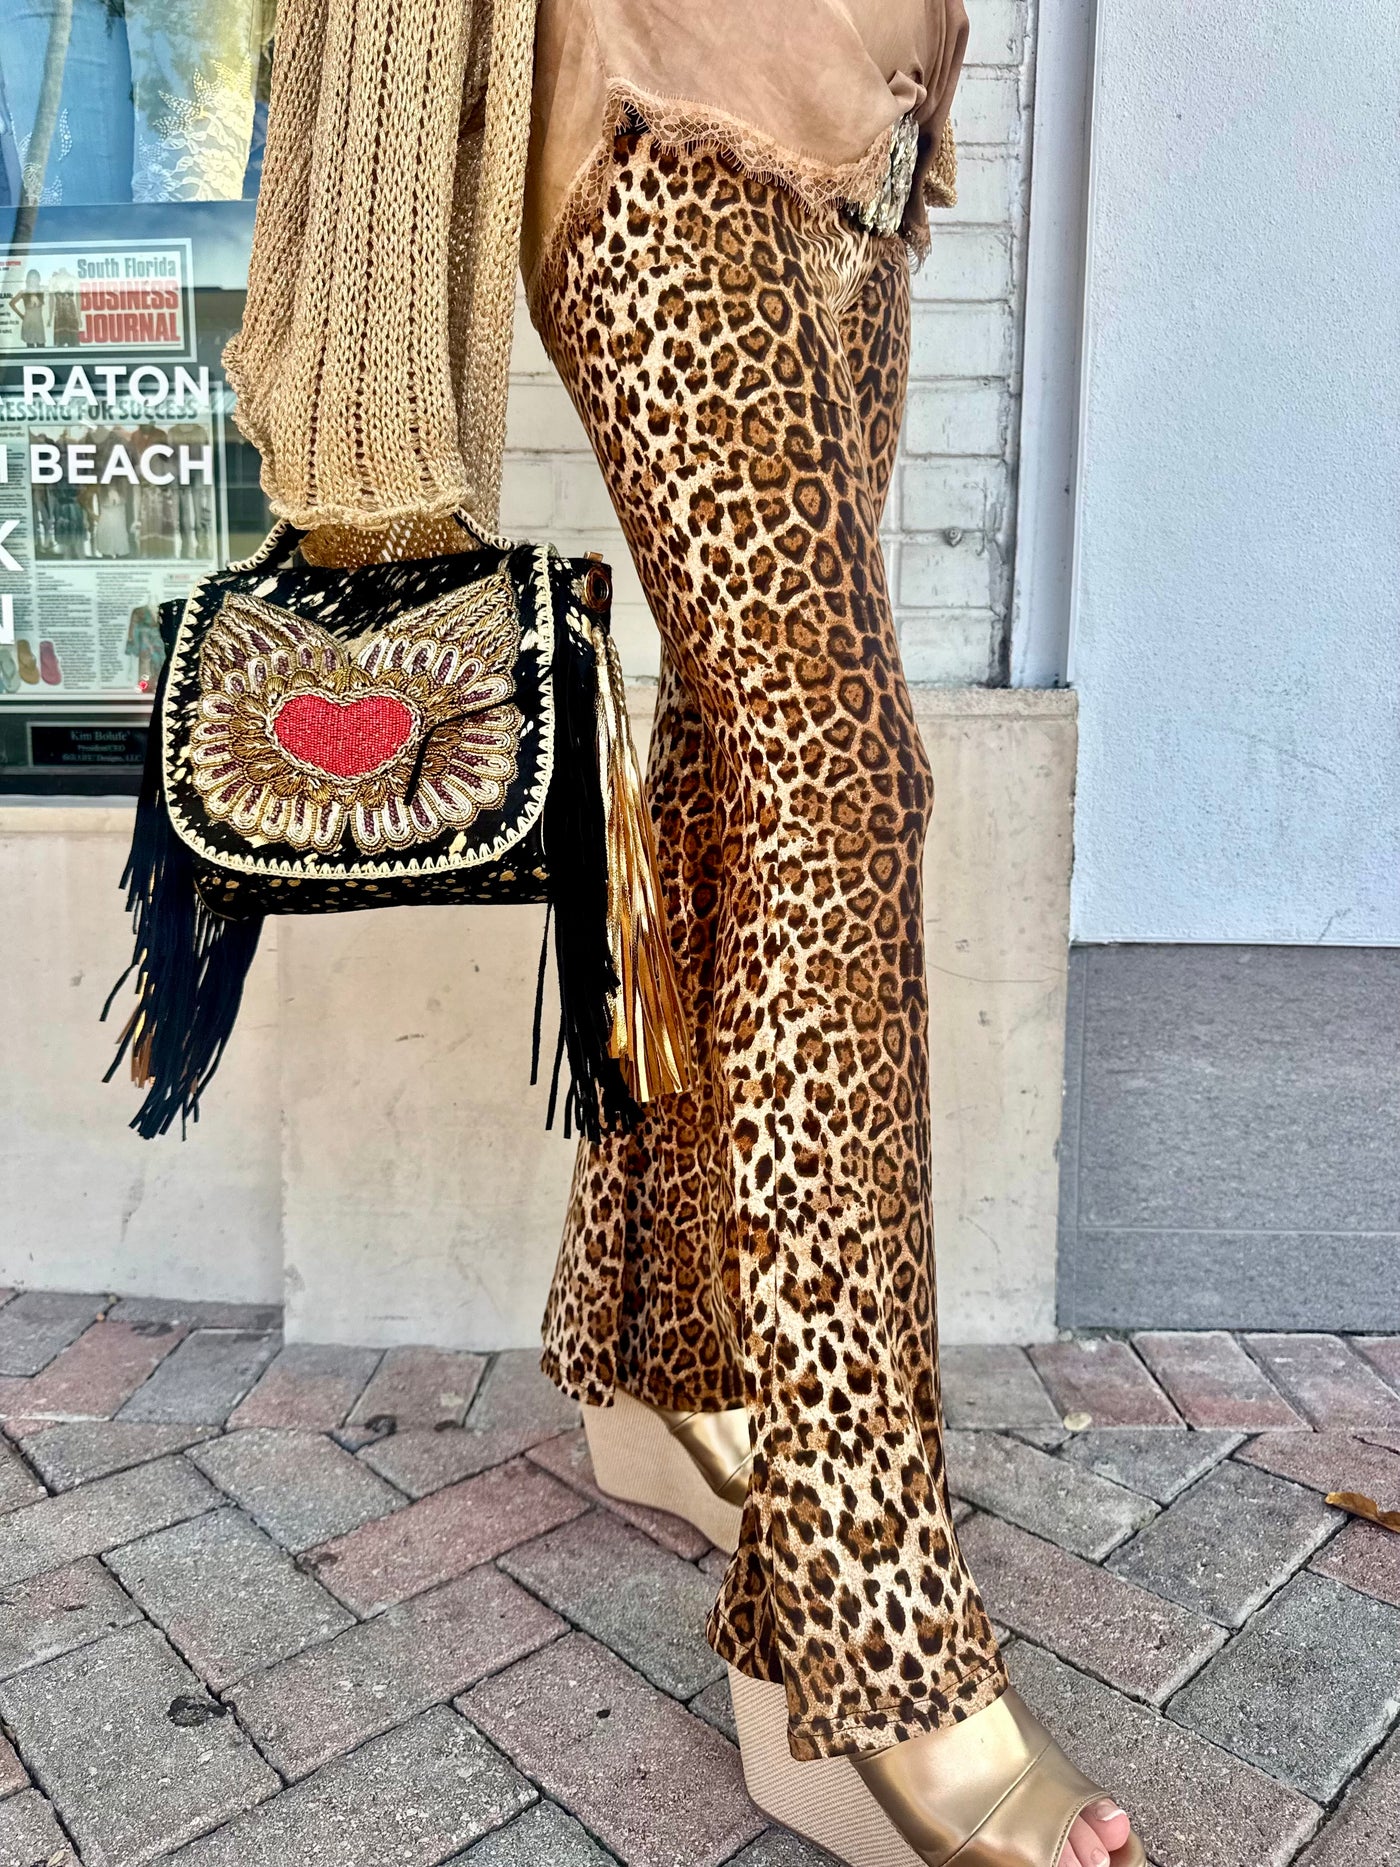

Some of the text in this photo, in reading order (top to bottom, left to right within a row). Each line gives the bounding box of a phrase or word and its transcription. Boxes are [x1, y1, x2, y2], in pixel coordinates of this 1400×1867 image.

[78, 256, 176, 278] South Florida
[80, 280, 179, 311] BUSINESS
[78, 312, 181, 344] JOURNAL
[23, 366, 209, 407] RATON
[119, 399, 198, 421] SUCCESS
[30, 444, 213, 485] BEACH
[70, 730, 92, 741] Kim
